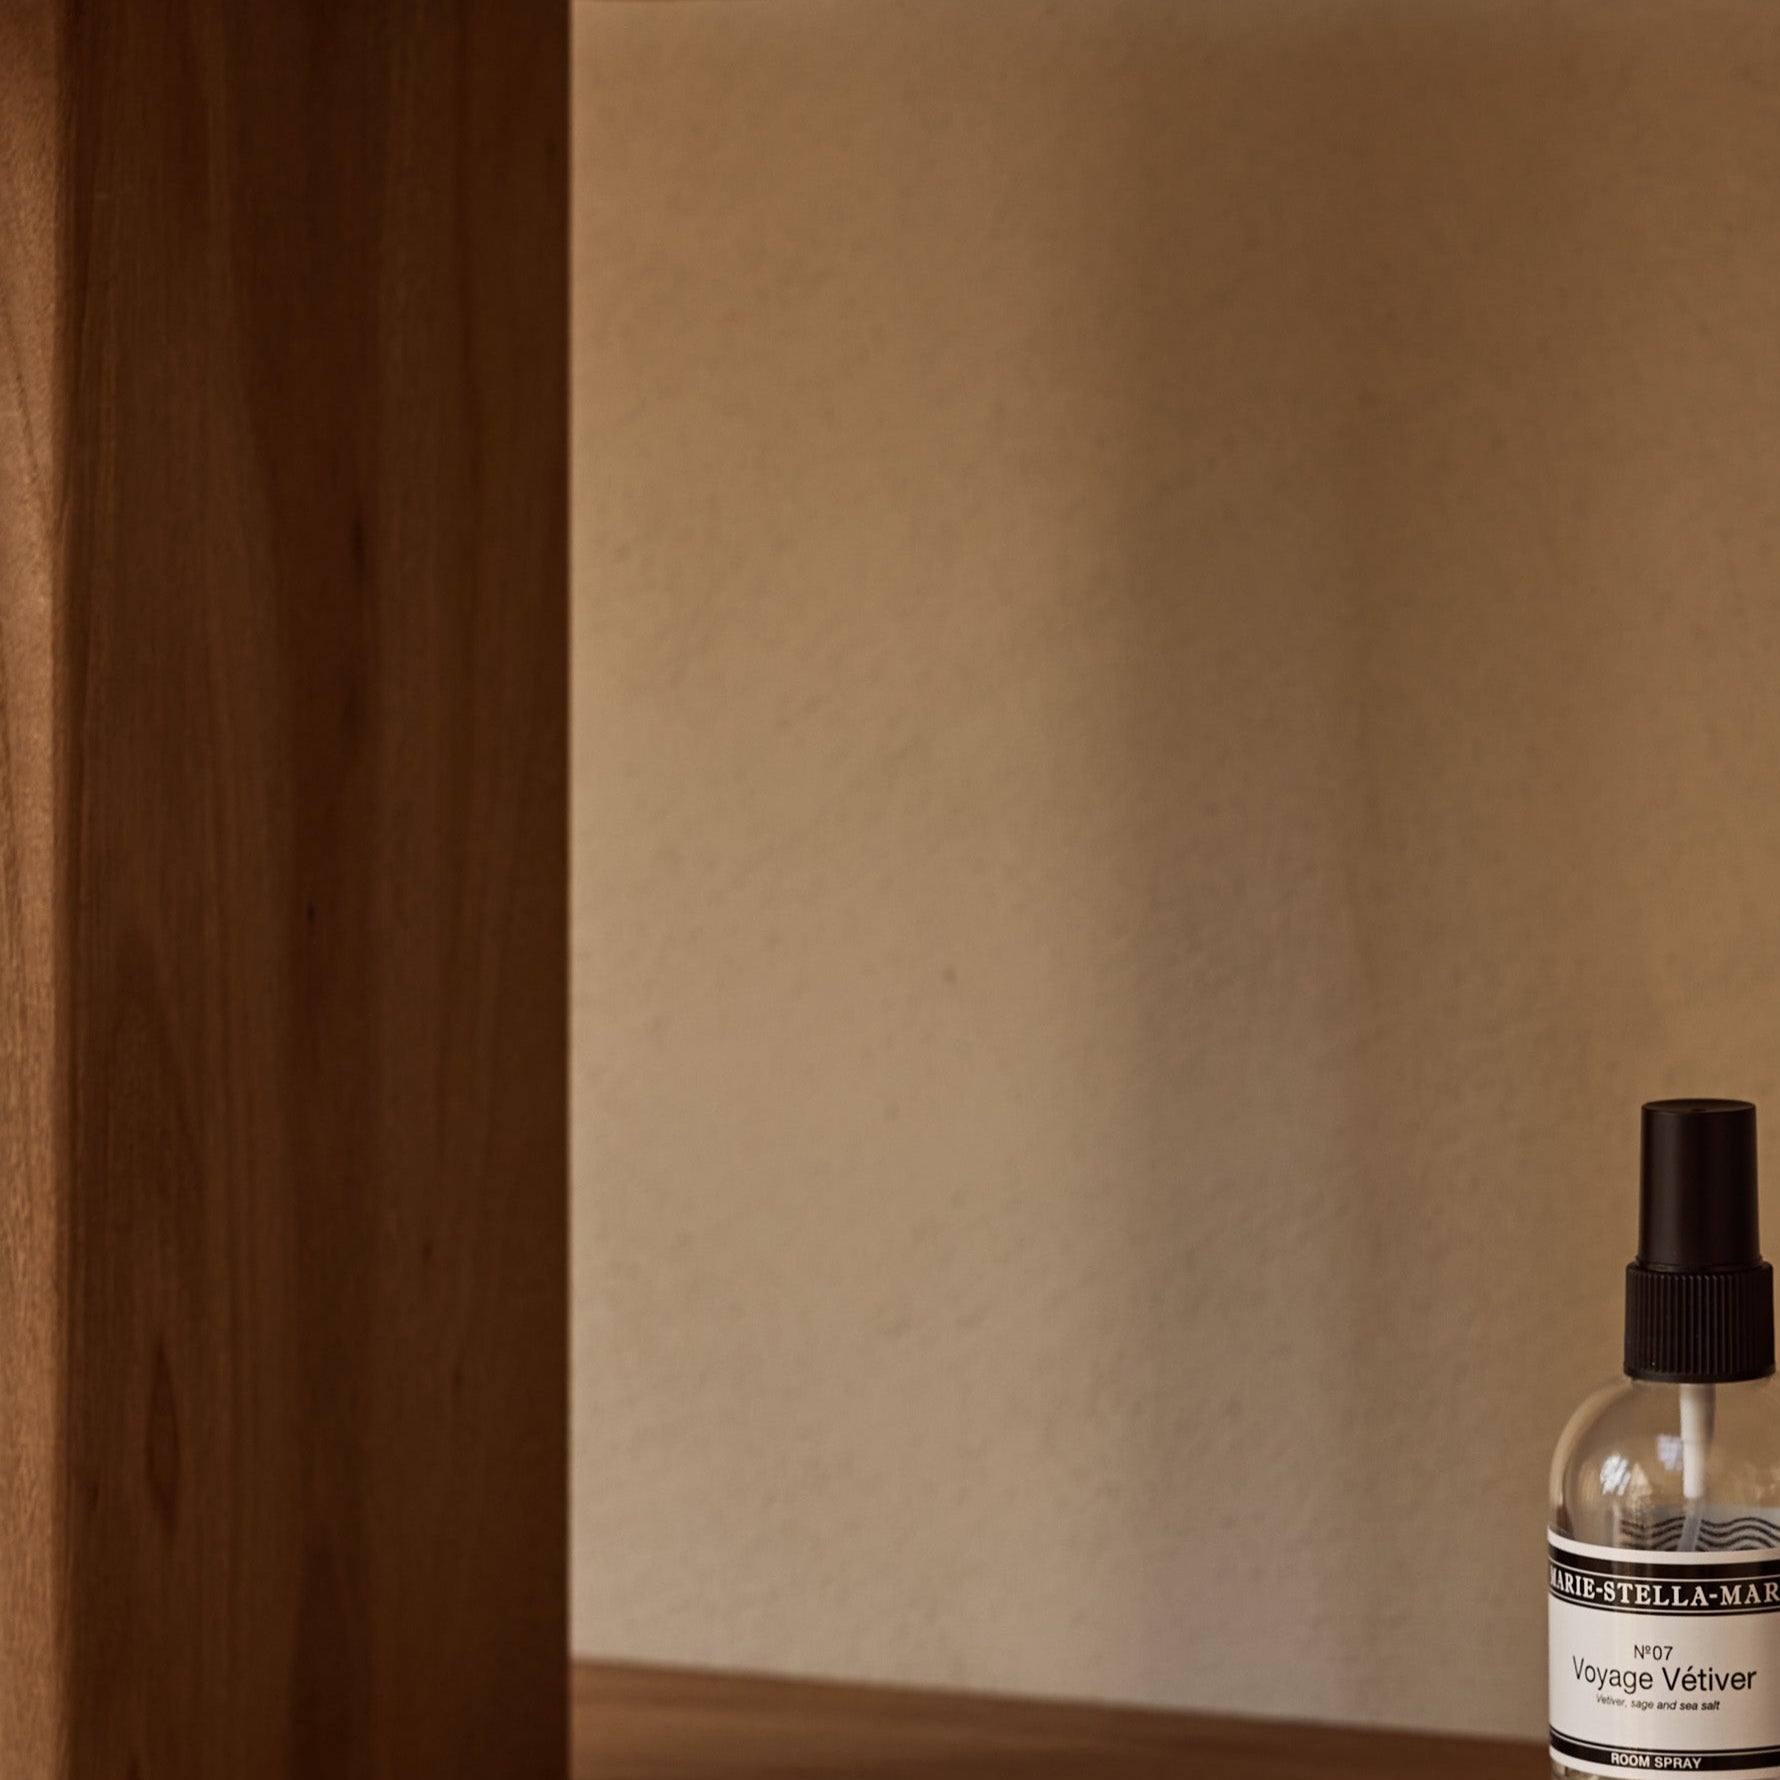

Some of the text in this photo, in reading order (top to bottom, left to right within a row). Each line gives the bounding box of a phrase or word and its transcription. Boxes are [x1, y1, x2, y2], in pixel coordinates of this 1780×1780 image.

[1573, 1655, 1757, 1694] Voyage Vétiver
[1631, 1699, 1654, 1710] sage
[1656, 1700, 1677, 1710] and
[1679, 1701, 1698, 1711] sea
[1701, 1700, 1720, 1711] salt
[1611, 1752, 1702, 1769] ROOM SPRAY
